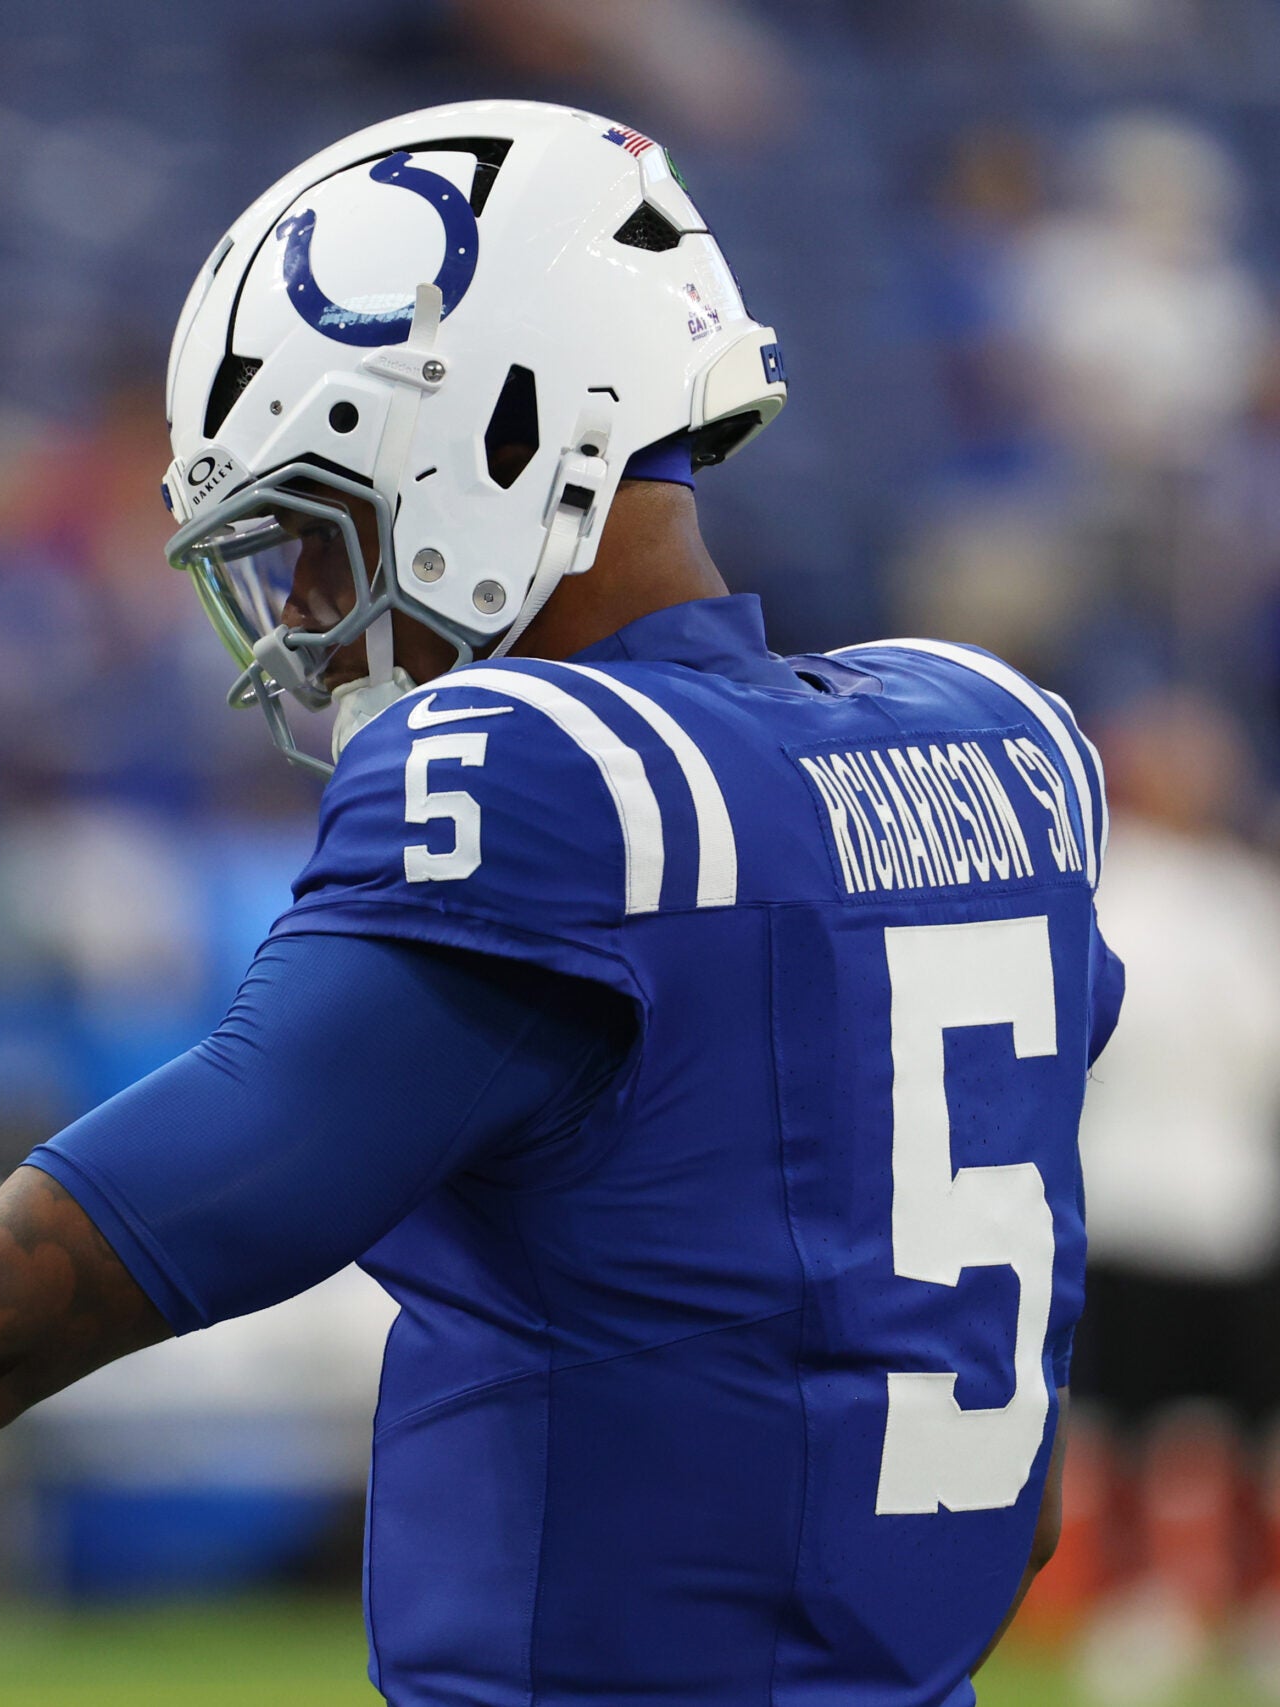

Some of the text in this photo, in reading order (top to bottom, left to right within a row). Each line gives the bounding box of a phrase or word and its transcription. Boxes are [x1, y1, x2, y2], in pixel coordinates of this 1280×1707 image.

[193, 461, 234, 505] OAKLEY
[404, 732, 489, 883] 5
[799, 741, 1035, 894] RICHARDSON
[875, 915, 1058, 1515] 5
